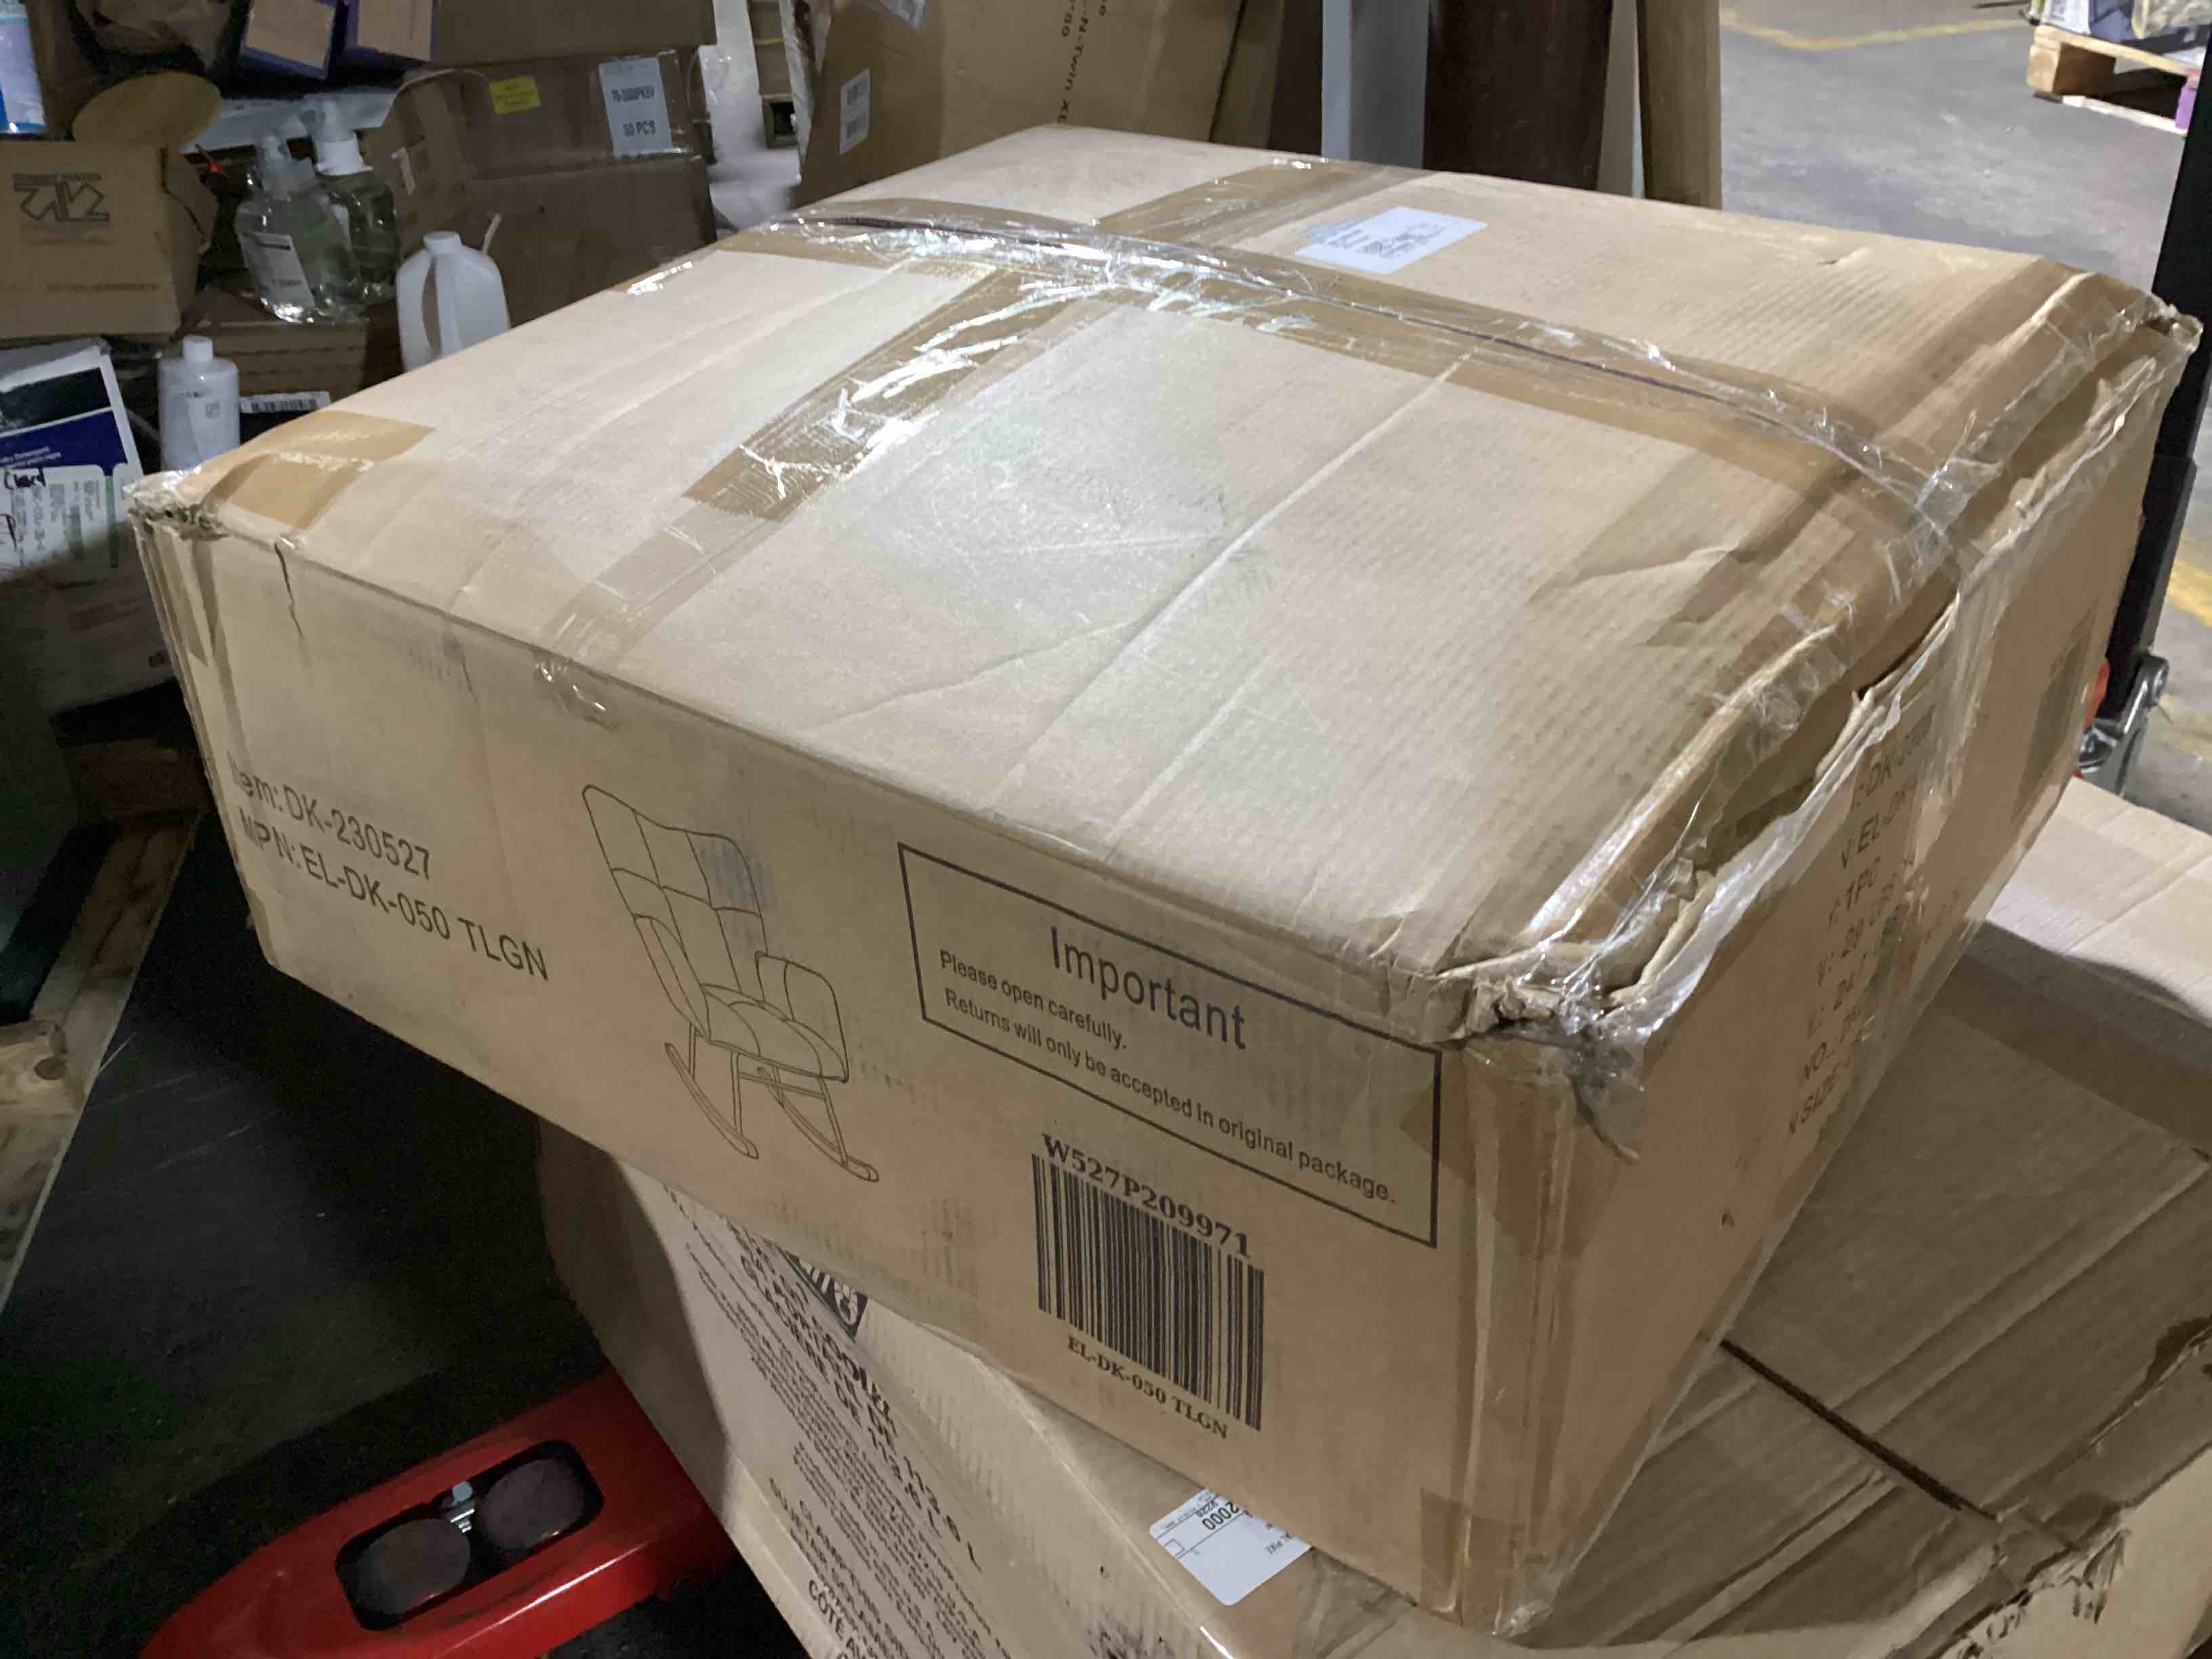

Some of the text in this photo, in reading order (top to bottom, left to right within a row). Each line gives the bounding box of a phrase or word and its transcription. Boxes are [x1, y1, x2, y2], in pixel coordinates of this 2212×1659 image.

[457, 916, 549, 981] TLGN
[939, 949, 1128, 1050] Please open carefully.
[1051, 926, 1246, 1050] Important
[945, 987, 1397, 1205] Returns will only be accepted in original package.
[1042, 1133, 1251, 1258] W527P209971
[1067, 1334, 1228, 1439] EL-DK-050 TLGN
[1202, 1500, 1240, 1531] 2000
